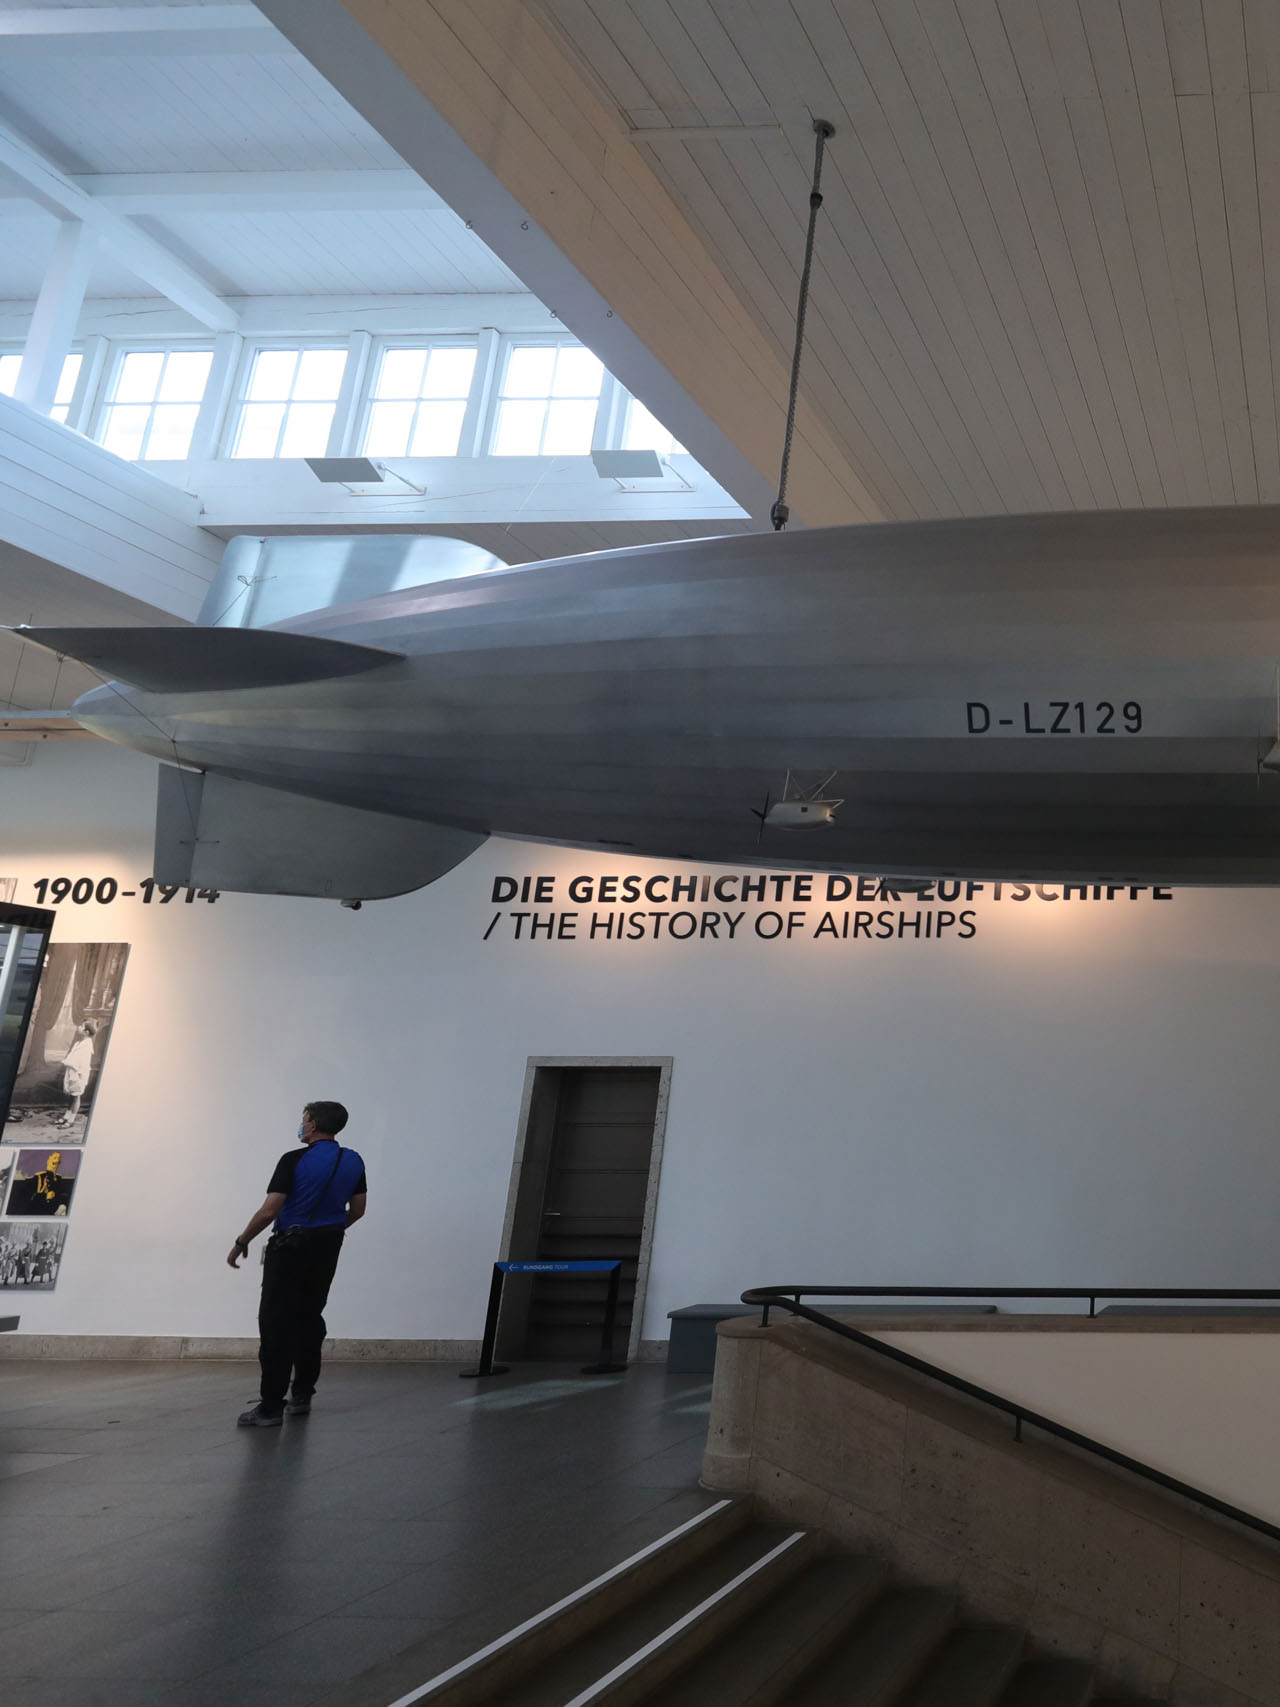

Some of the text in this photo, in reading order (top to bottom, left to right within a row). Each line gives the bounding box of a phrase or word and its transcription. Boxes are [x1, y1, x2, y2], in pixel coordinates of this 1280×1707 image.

[966, 701, 1143, 734] D-LZ129
[491, 875, 556, 903] DIE
[568, 875, 814, 903] GESCHICHTE
[510, 911, 578, 940] THE
[589, 911, 746, 940] HISTORY
[754, 911, 806, 939] OF
[813, 910, 977, 939] AIRSHIPS
